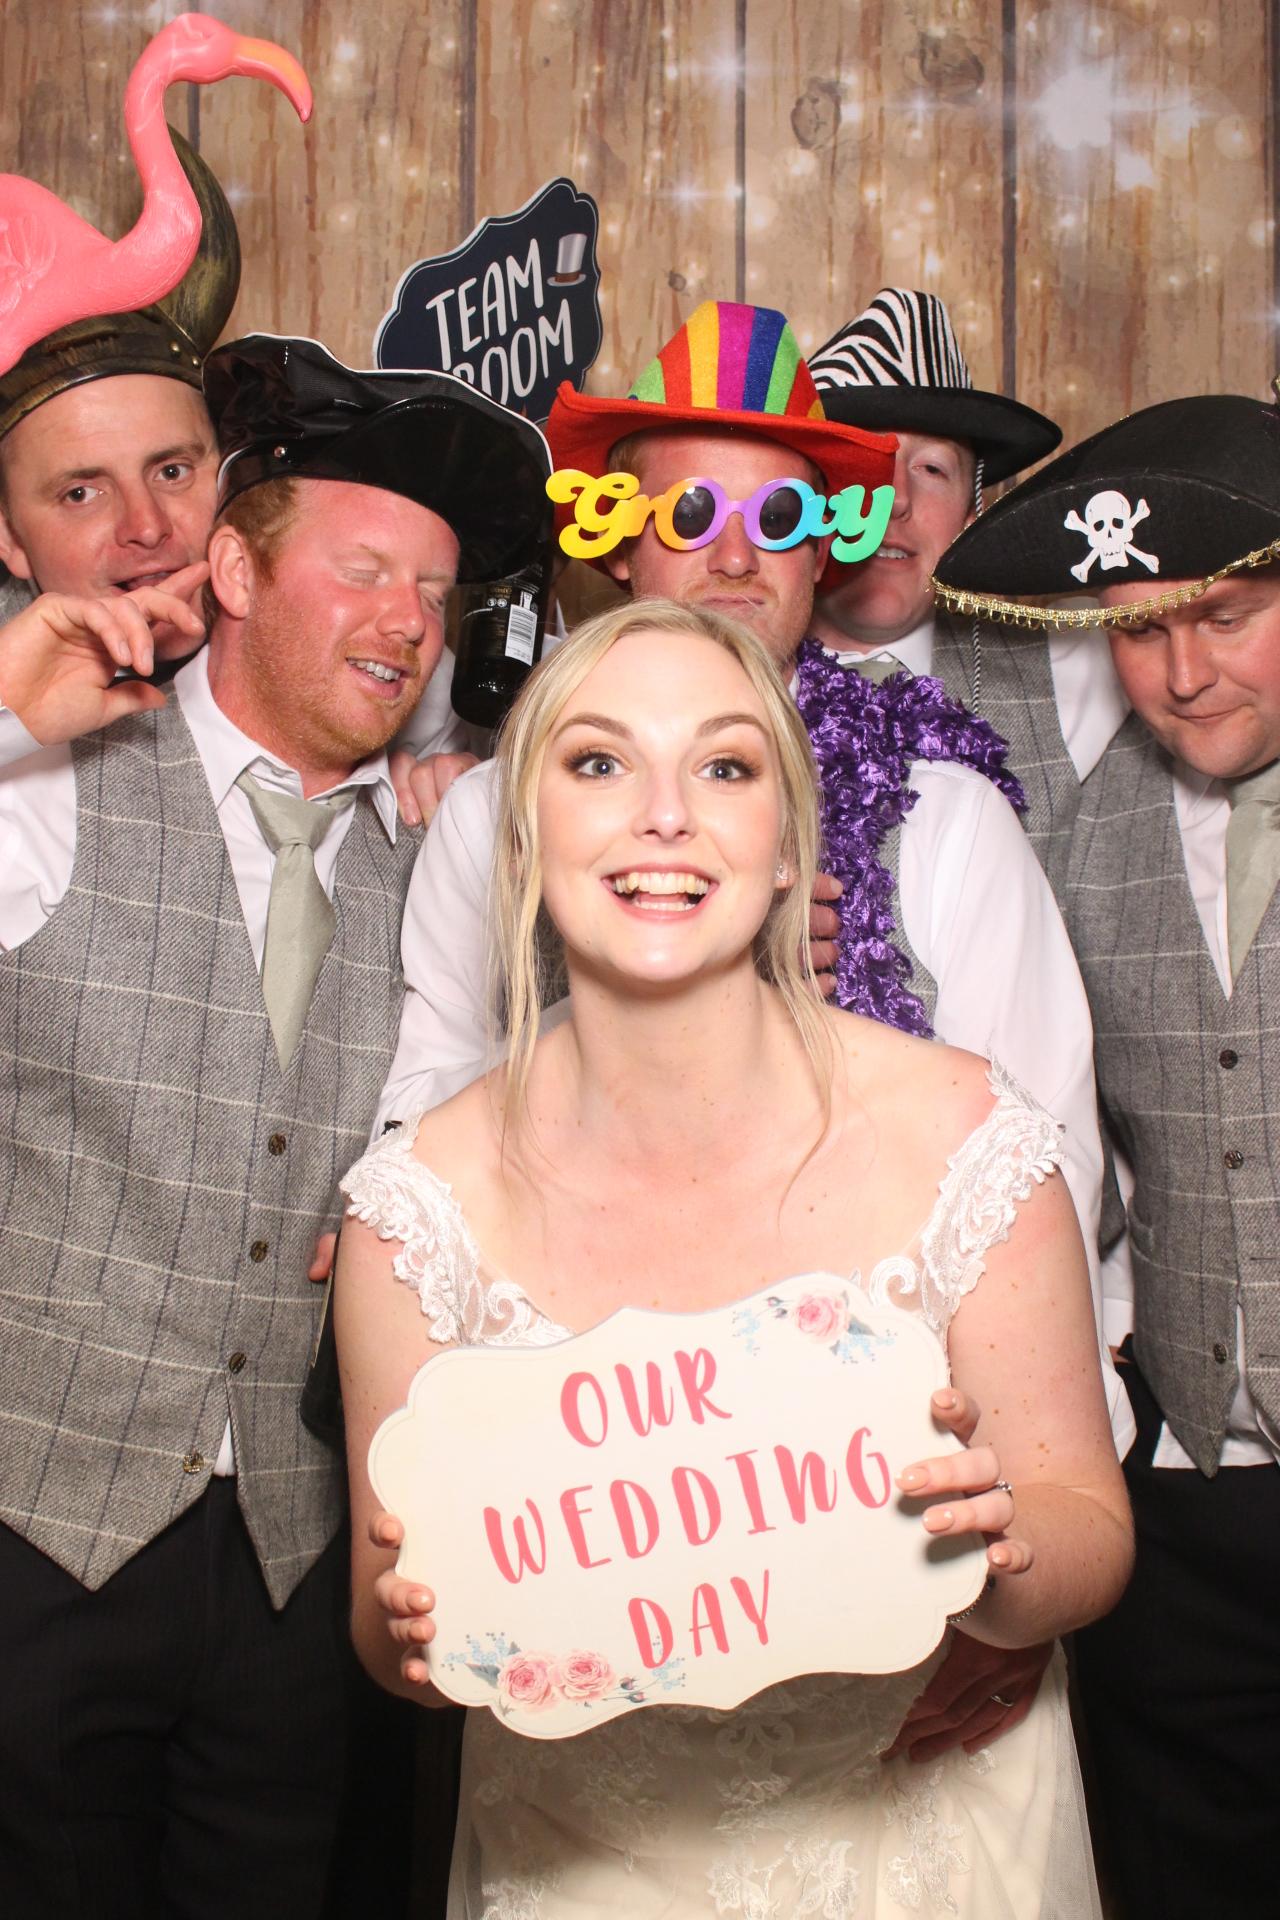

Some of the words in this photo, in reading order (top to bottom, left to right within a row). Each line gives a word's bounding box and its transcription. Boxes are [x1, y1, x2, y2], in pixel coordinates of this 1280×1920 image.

[425, 238, 544, 371] TEAM
[452, 298, 574, 406] OOM
[560, 1347, 732, 1448] OUR
[483, 1427, 891, 1584] WEDDING
[627, 1569, 770, 1669] DAY
